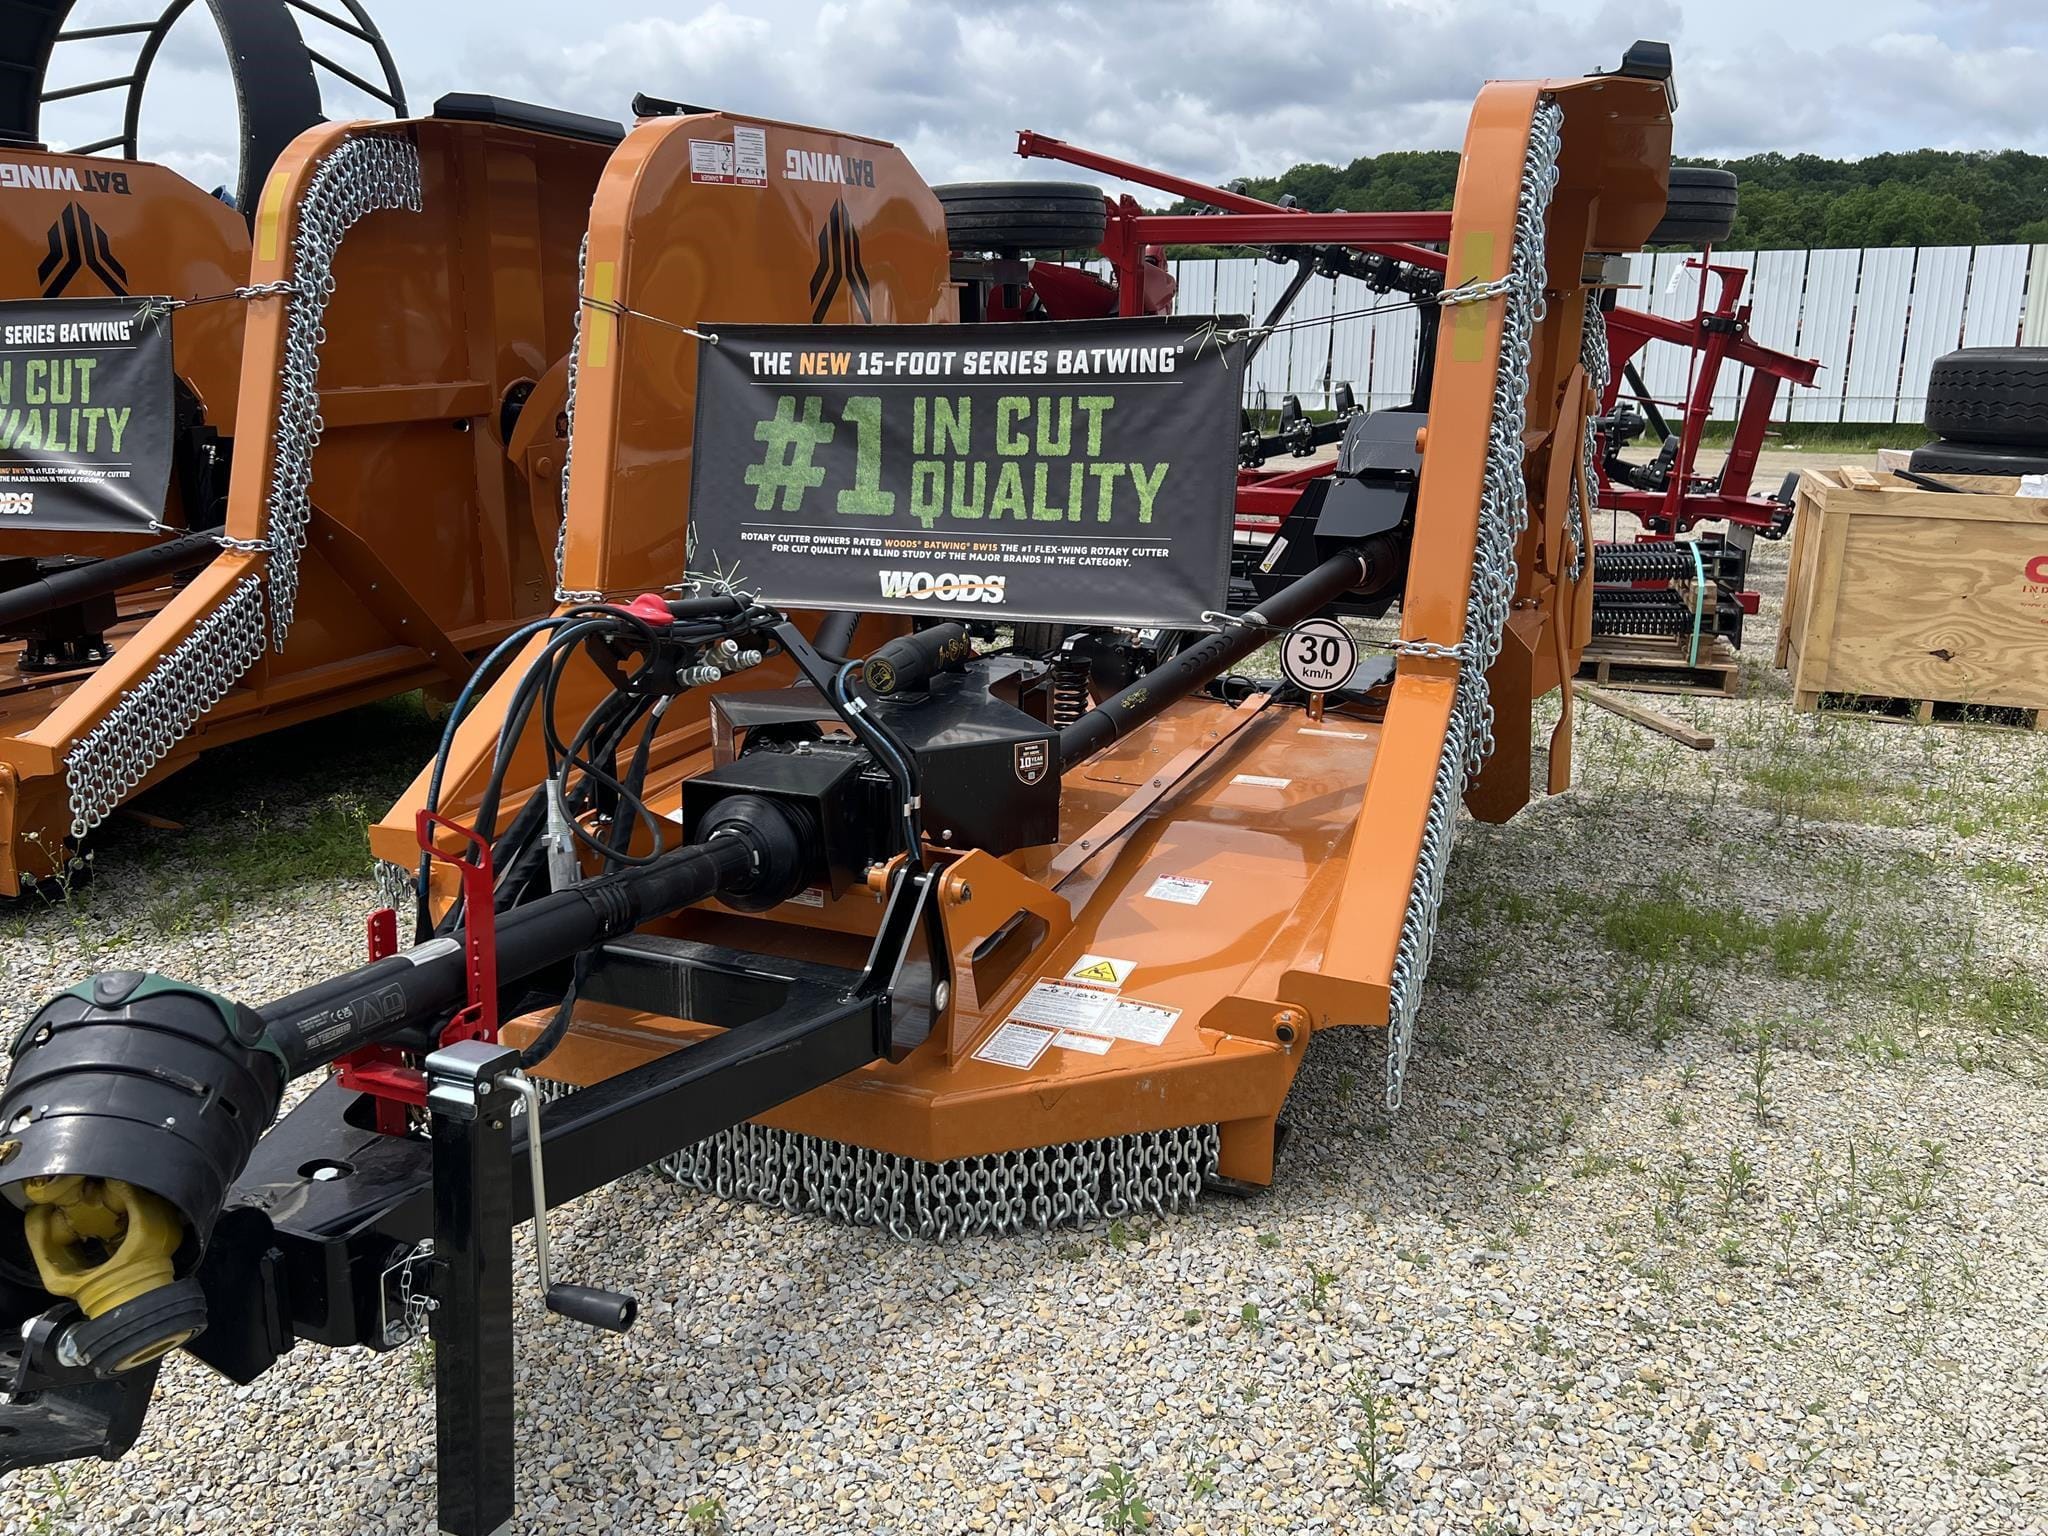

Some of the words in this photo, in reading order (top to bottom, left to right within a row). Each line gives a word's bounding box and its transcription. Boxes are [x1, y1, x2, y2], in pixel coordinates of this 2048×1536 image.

[5, 324, 55, 345] SERIES
[750, 351, 792, 375] THE
[800, 352, 851, 375] NEW
[857, 352, 956, 375] 15-FOOT
[963, 350, 1047, 375] SERIES
[26, 358, 97, 405] CUT
[912, 396, 972, 456] IN
[996, 395, 1115, 457] CUT
[744, 395, 896, 517] #1
[909, 459, 1169, 529] QUALITY
[741, 532, 775, 542] ROTARY
[778, 533, 811, 544] CUTTER
[813, 535, 851, 545] OWNERS
[853, 536, 882, 546] RATED
[973, 543, 997, 552] BW15
[1000, 543, 1019, 553] THE
[1021, 545, 1032, 553] #1
[1035, 544, 1088, 555] FLEX-WING
[1090, 546, 1129, 557] ROTARY
[1132, 548, 1169, 558] CUTTER
[772, 543, 789, 553] FOR
[791, 544, 809, 554] CUT
[810, 545, 849, 556] QUALITY
[851, 546, 861, 556] IN
[863, 547, 871, 557] A
[873, 548, 901, 558] BLIND
[902, 549, 933, 559] STUDY
[934, 550, 946, 560] OF
[948, 551, 967, 561] THE
[968, 552, 1001, 562] MAJOR
[1003, 553, 1041, 564] BRANDS
[1043, 555, 1055, 564] IN
[1057, 556, 1076, 565] THE
[1078, 557, 1132, 568] CATEGORY.
[879, 570, 1006, 604] WOODS
[1298, 636, 1340, 667] 30
[1303, 667, 1333, 680] km/h
[1020, 757, 1031, 769] 10
[1064, 981, 1106, 993] WARNING
[1018, 1021, 1056, 1033] WARNING
